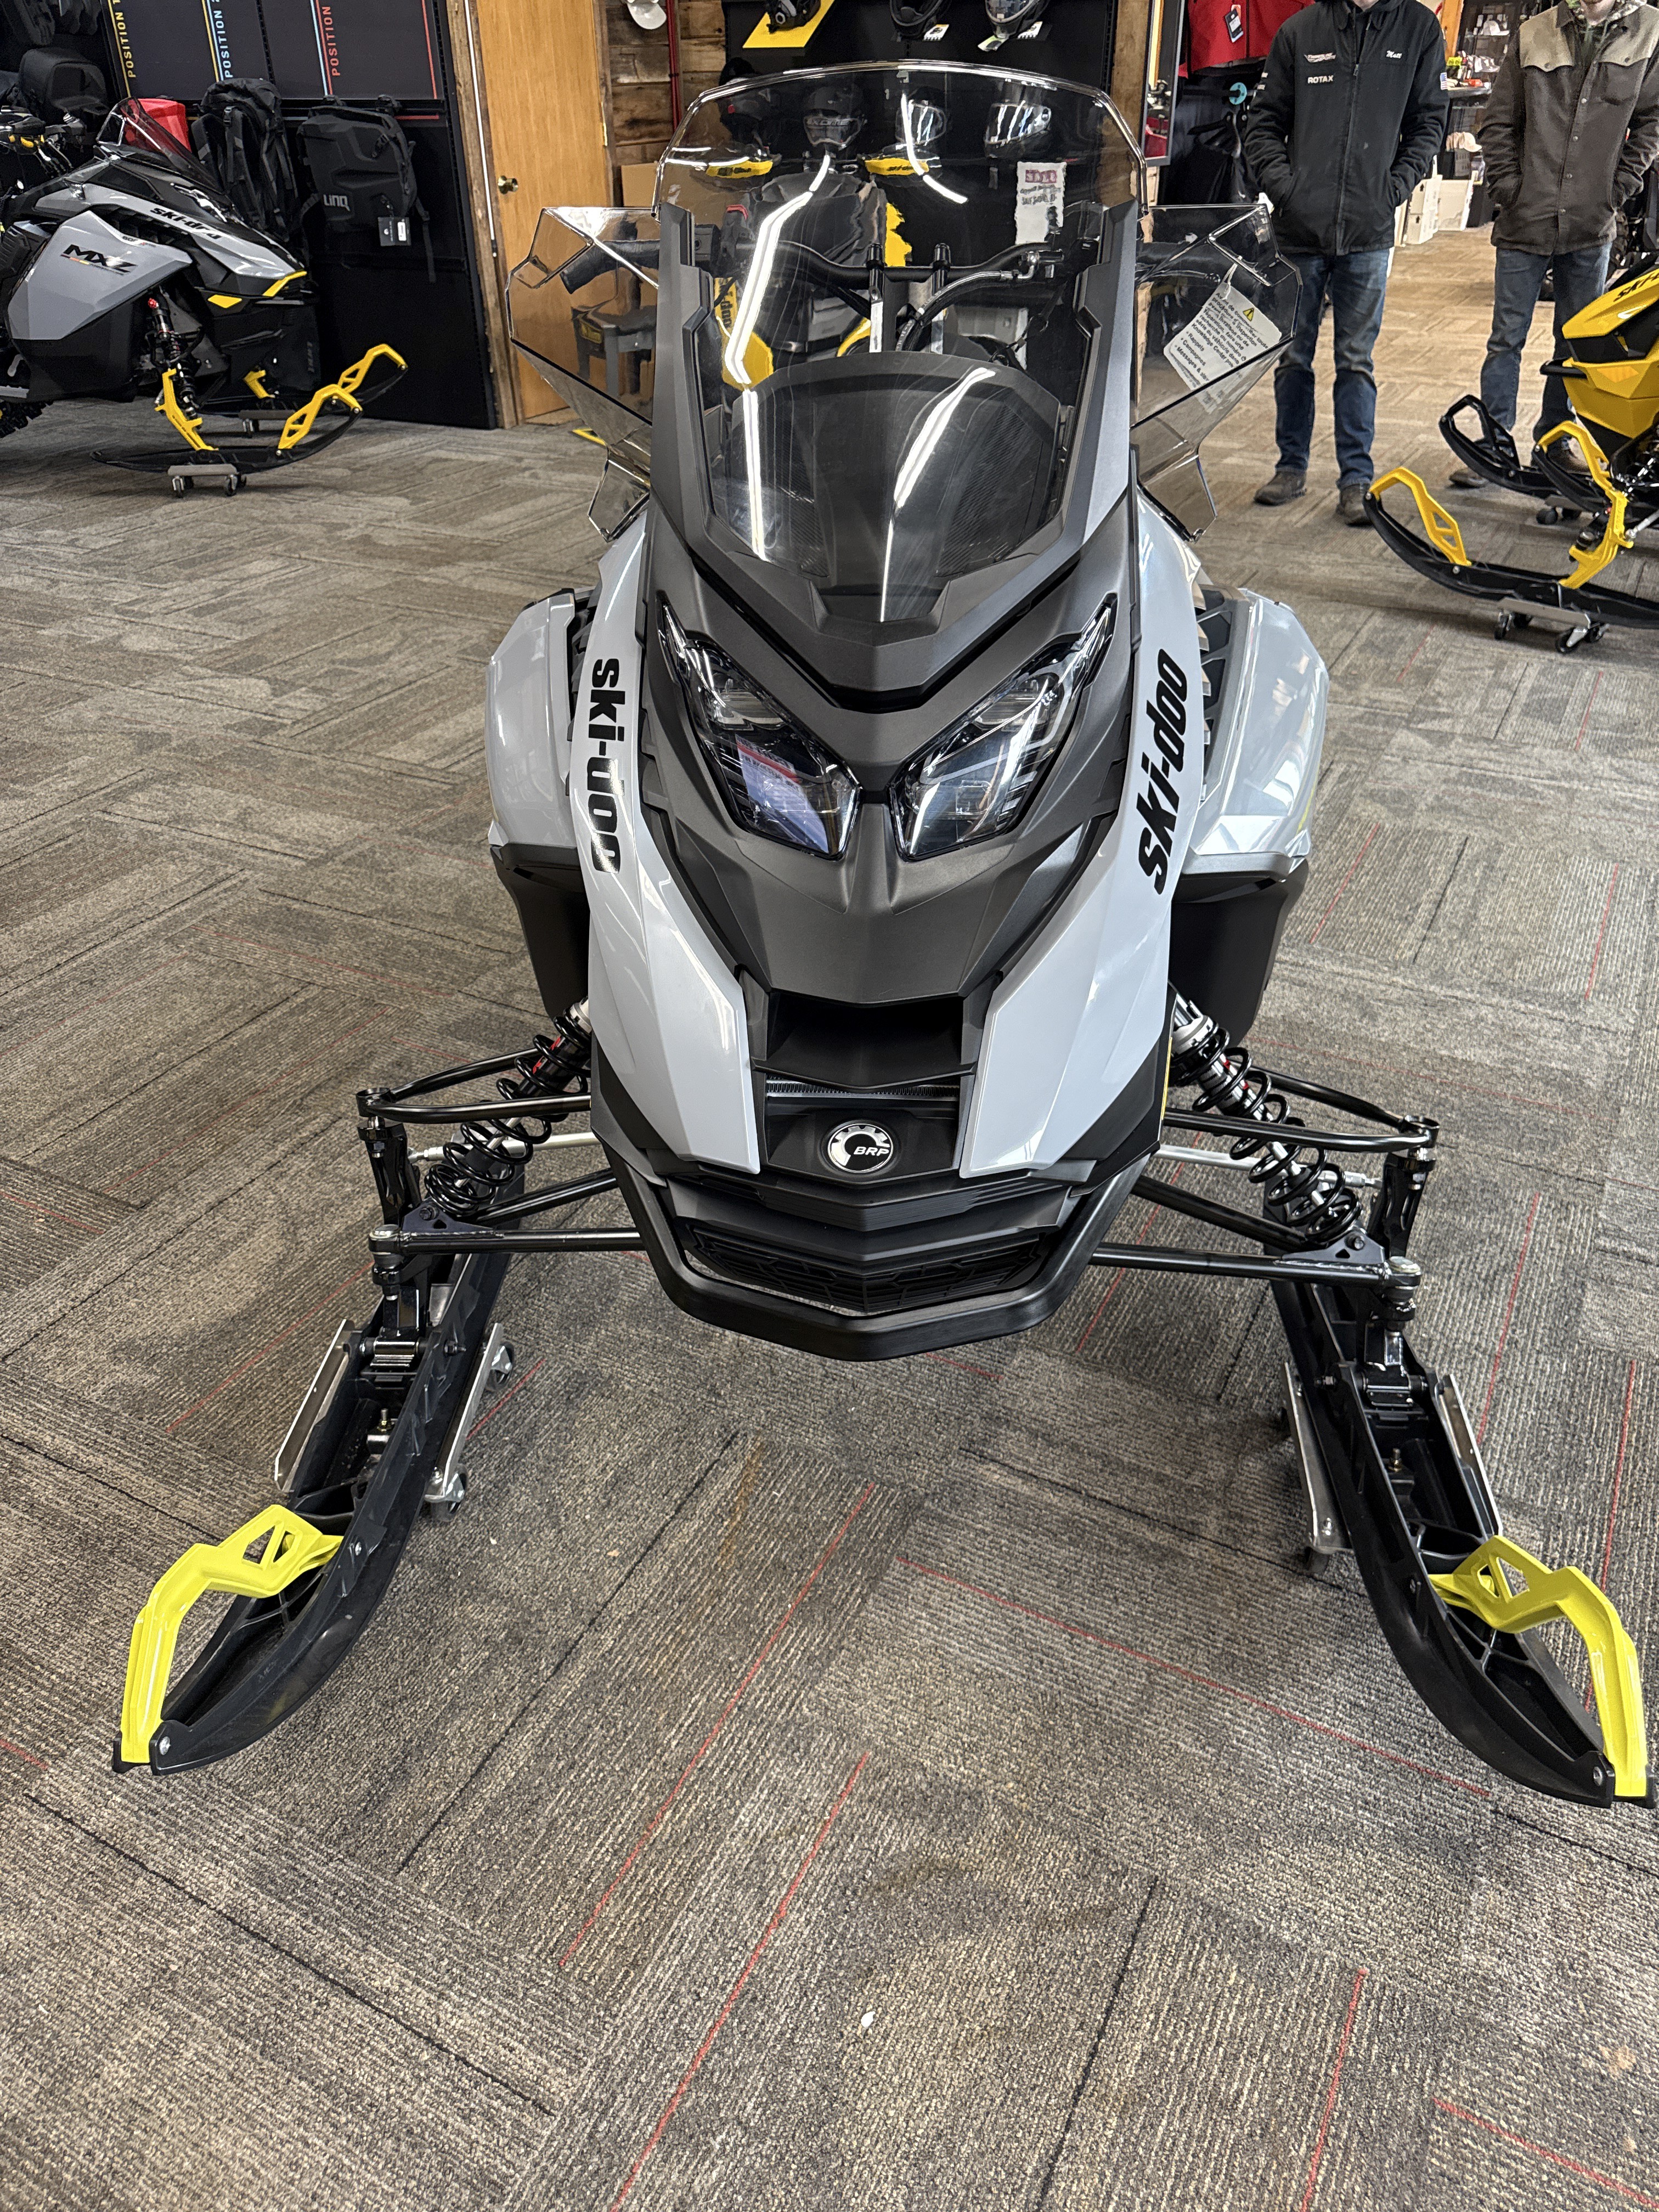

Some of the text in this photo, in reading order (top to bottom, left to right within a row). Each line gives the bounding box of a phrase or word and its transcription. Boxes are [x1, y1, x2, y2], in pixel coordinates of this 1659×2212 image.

[115, 12, 137, 78] POSITION
[213, 10, 233, 78] POSITION
[321, 6, 341, 77] POSITION
[1307, 75, 1334, 84] ROTAX
[63, 244, 137, 273] MXZ
[1199, 314, 1220, 335] recherche
[1183, 340, 1206, 366] Campagnes
[1188, 333, 1205, 352] Rappels
[1192, 323, 1214, 347] Knowledge
[1213, 345, 1227, 360] Center
[1234, 341, 1244, 351] une
[1176, 347, 1197, 369] Messages
[587, 659, 625, 873] ski-doo
[1136, 649, 1187, 894] ski-doo
[853, 1146, 889, 1156] BRP
